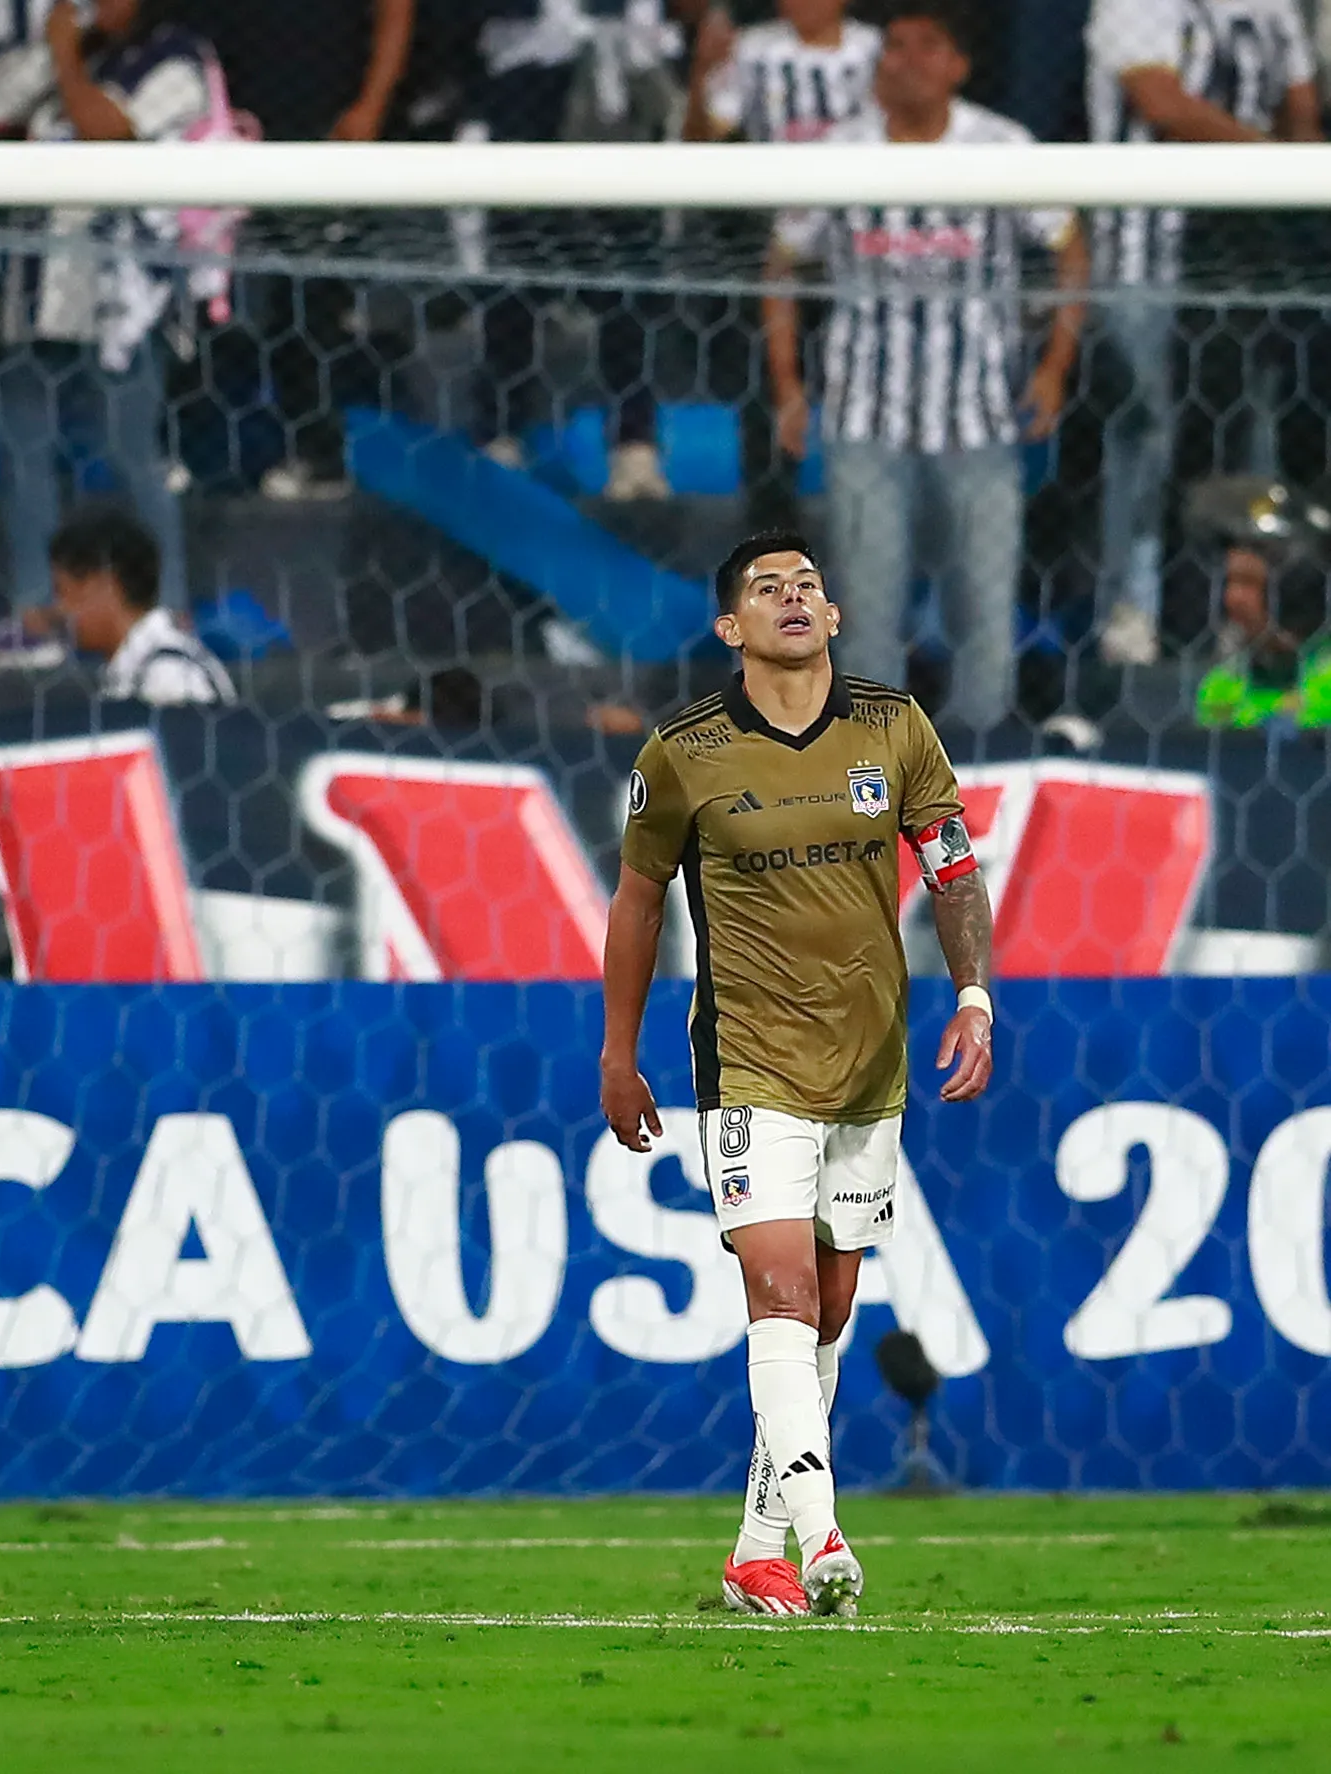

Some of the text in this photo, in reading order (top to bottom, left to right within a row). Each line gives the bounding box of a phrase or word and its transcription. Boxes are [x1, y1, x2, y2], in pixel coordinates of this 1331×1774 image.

[851, 702, 899, 717] Pilsen
[675, 723, 730, 751] Pilsen
[770, 792, 846, 807] JETOUR
[733, 841, 857, 873] COOLBET
[720, 1105, 752, 1158] 8
